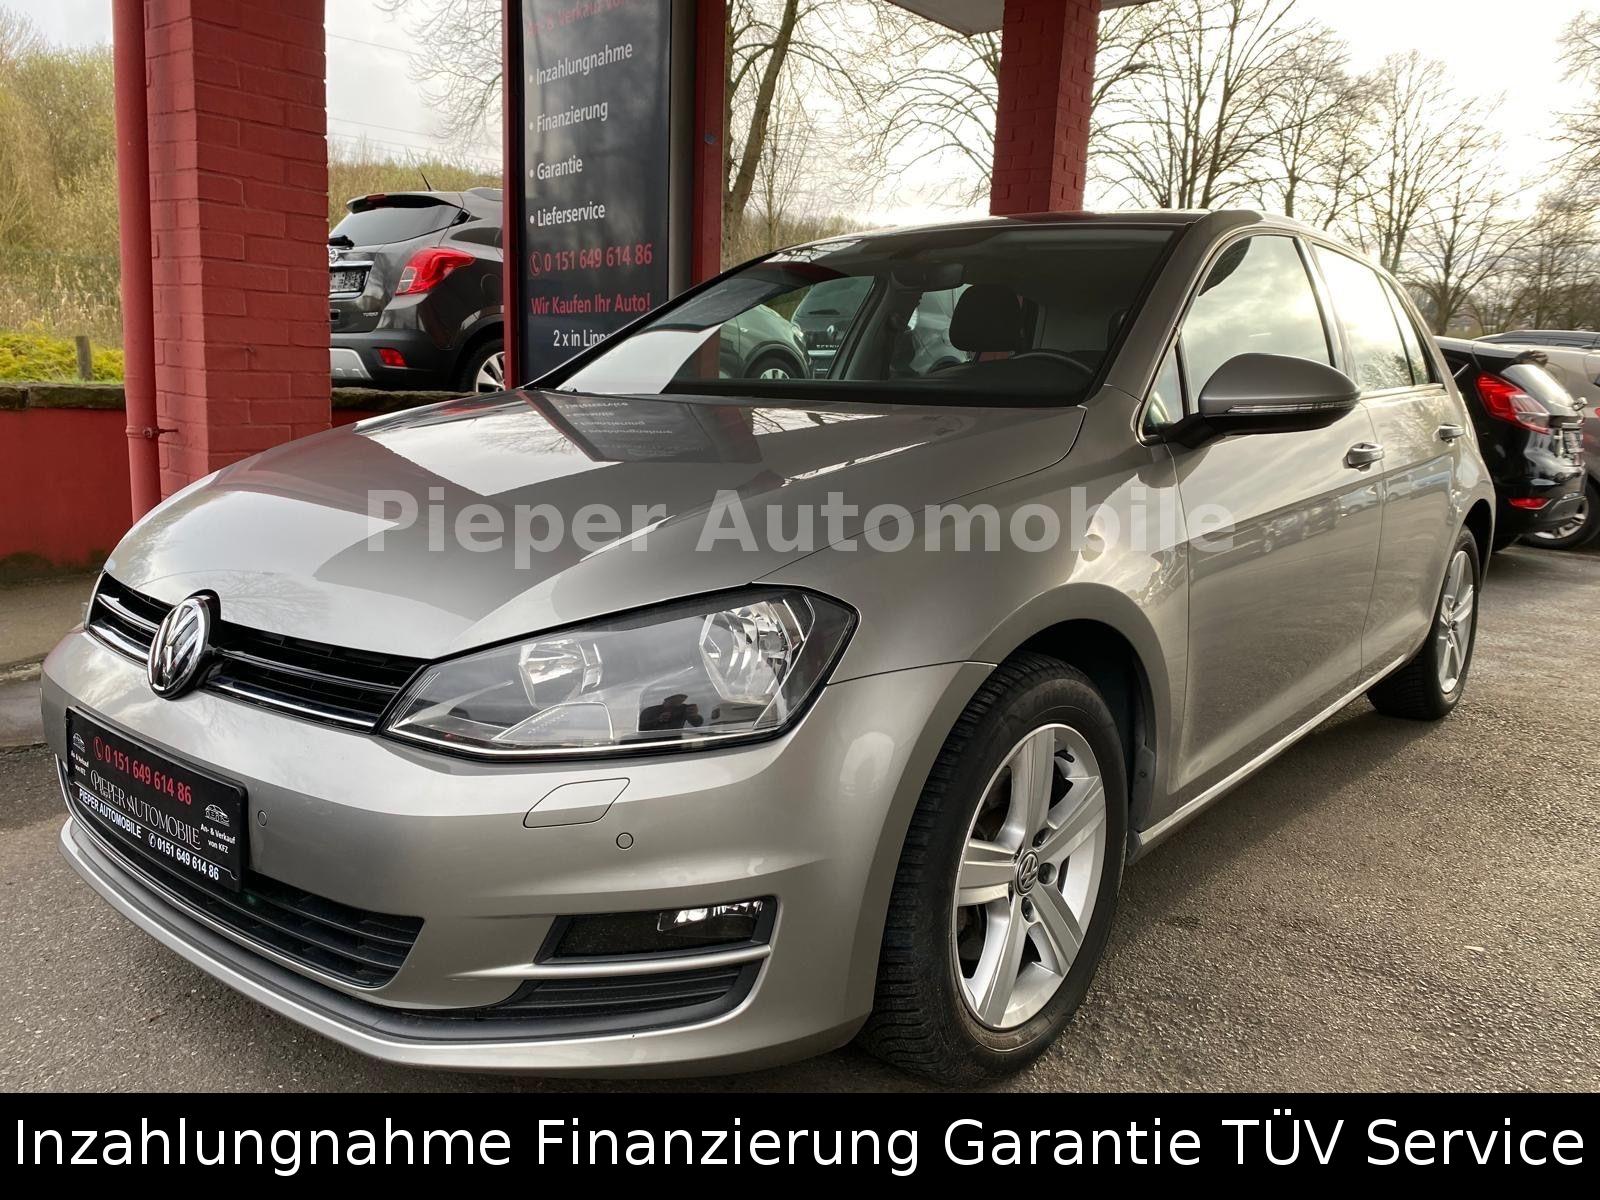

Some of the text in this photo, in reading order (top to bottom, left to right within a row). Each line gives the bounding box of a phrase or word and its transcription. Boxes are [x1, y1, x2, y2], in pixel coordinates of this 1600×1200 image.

[536, 43, 633, 86] Inzahlungnahme
[536, 102, 609, 133] Finanzierung
[536, 155, 583, 180] Garantie
[537, 202, 606, 227] Lieferservice
[544, 244, 652, 272] 0 151 649 614 86
[531, 293, 651, 315] Wir Kaufen Ihr Auto!
[553, 329, 560, 347] 2
[562, 333, 569, 347] x
[571, 329, 581, 347] in
[105, 745, 111, 763] 0
[113, 750, 130, 774] 151
[132, 760, 151, 784] 649
[154, 771, 174, 797] 614
[177, 781, 192, 806] 86
[91, 770, 202, 850] PIEPER AUTOMOBILE
[78, 788, 99, 812] PIEPER
[99, 803, 142, 839] AUTOMOBILE
[157, 838, 175, 858] 0151
[176, 848, 191, 867] 649
[192, 857, 207, 875] 614
[208, 865, 220, 881] 86
[215, 829, 236, 845] Verkauf
[218, 842, 229, 854] KFZ
